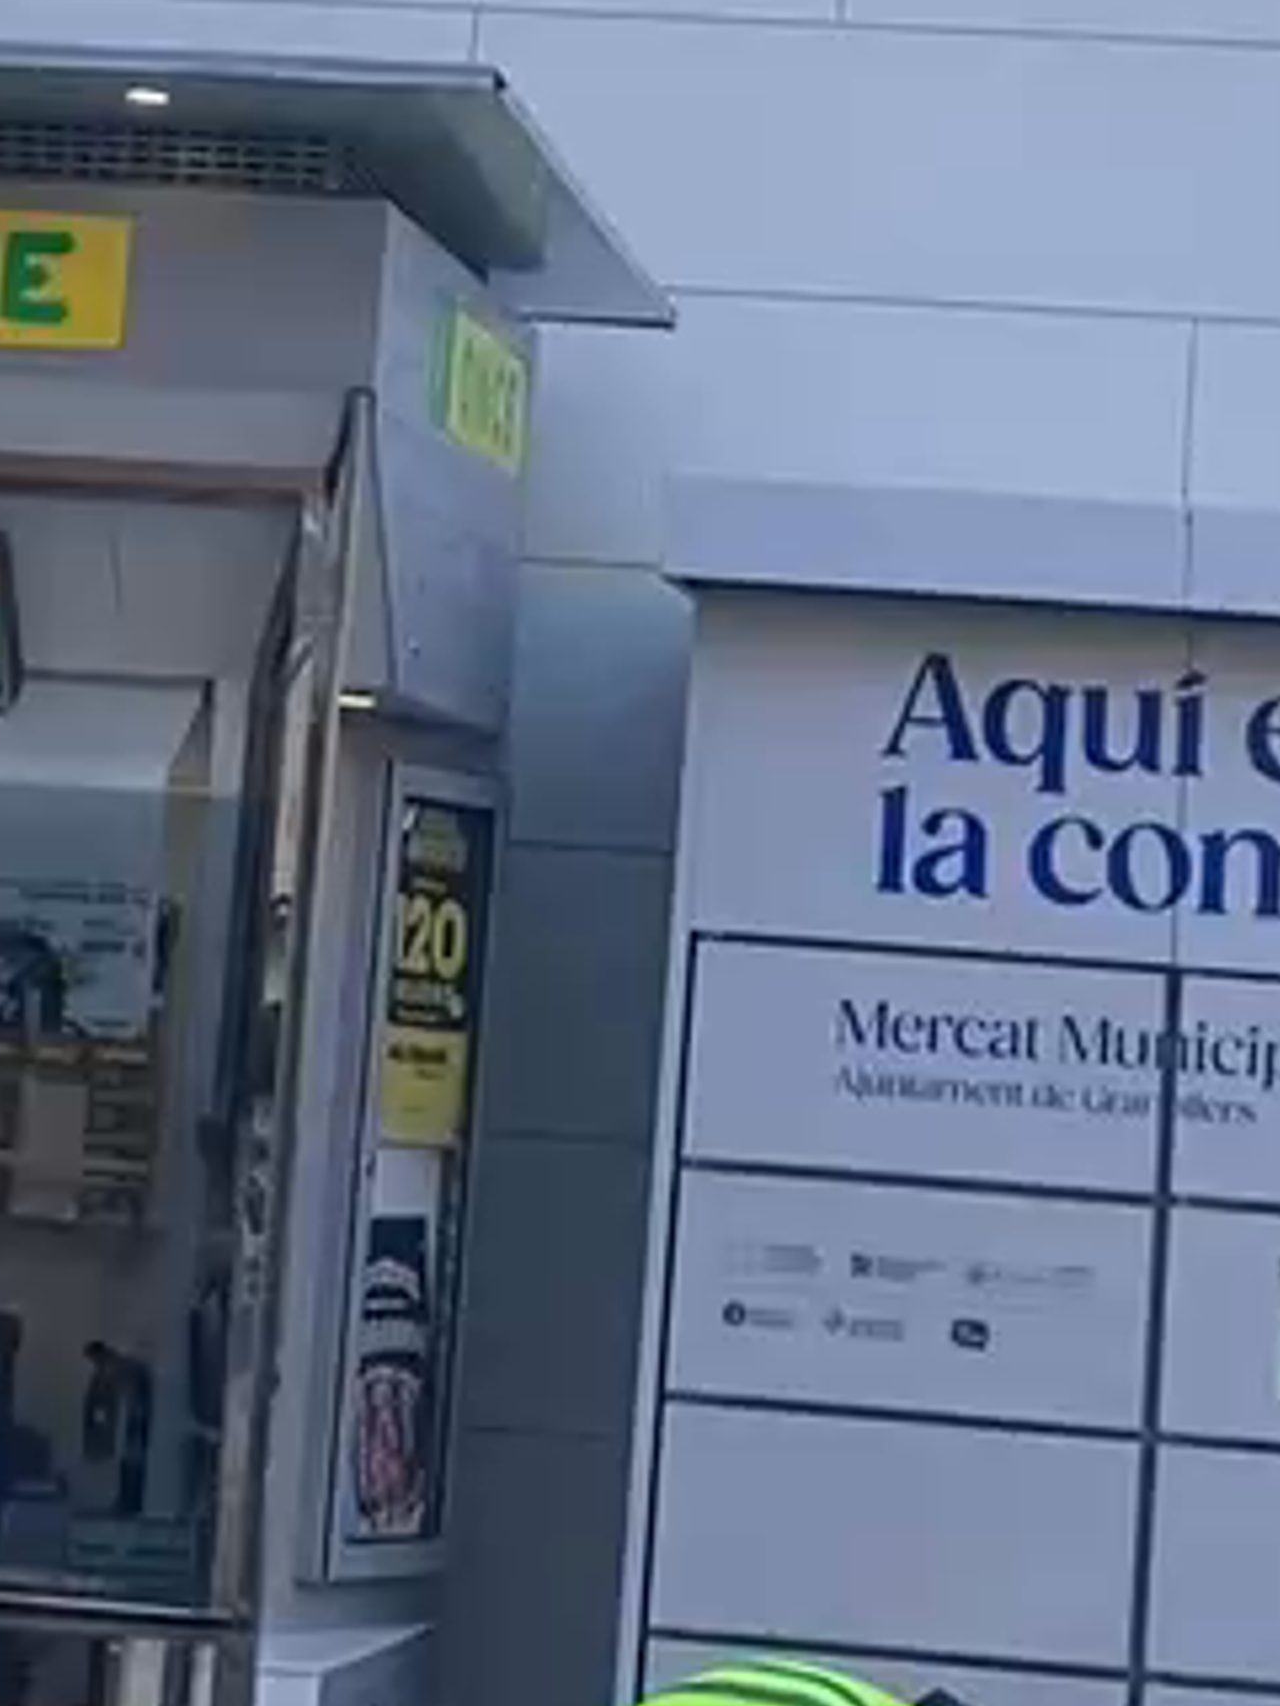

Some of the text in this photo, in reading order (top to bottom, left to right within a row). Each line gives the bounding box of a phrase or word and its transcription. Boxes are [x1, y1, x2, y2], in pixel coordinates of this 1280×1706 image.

[880, 650, 1209, 794] Aquí
[876, 785, 988, 900] la
[836, 998, 1041, 1063] Mercat
